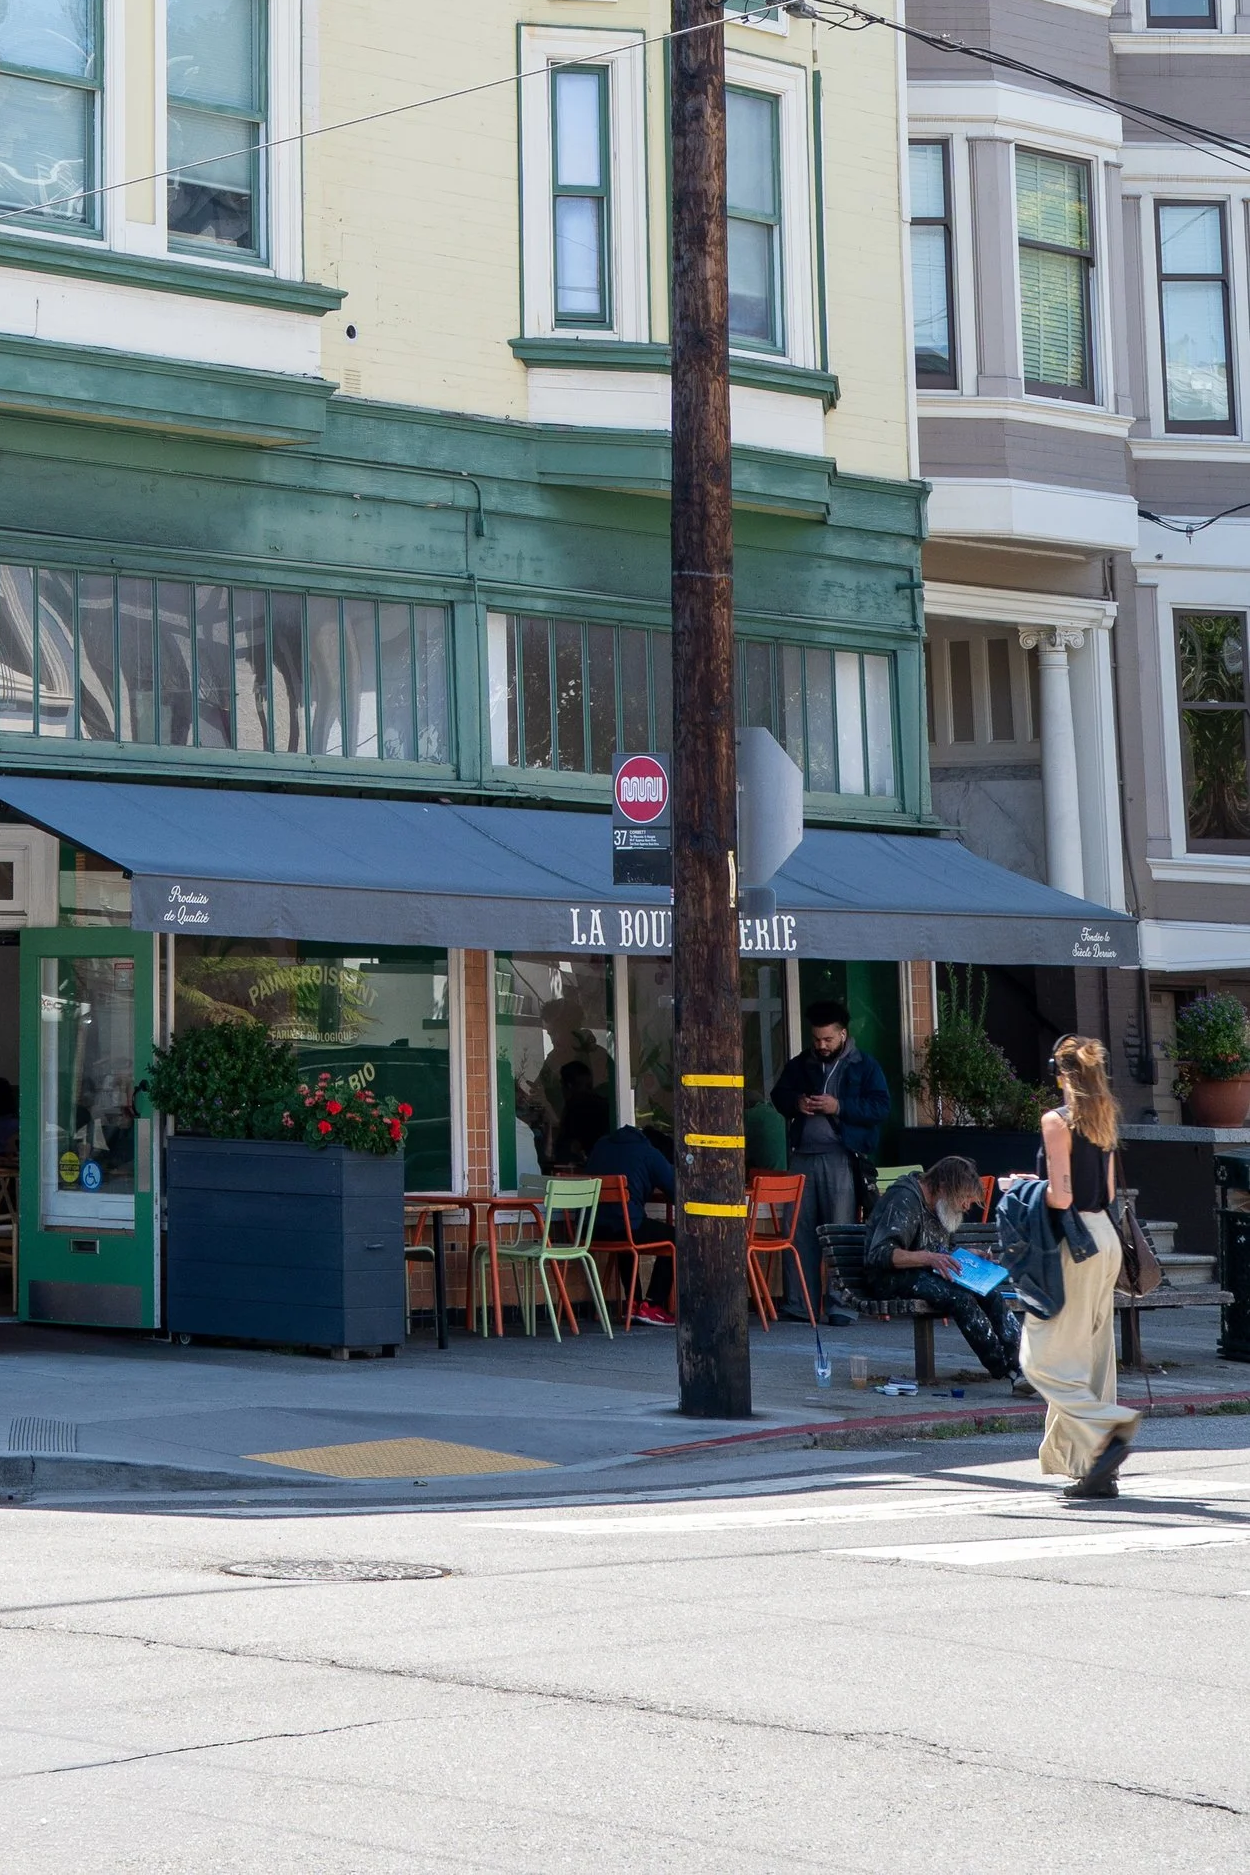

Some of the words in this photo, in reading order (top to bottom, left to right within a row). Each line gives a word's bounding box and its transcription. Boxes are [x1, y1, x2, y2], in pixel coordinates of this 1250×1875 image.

[613, 830, 628, 846] 37
[168, 885, 210, 905] Produits
[163, 910, 177, 922] de
[177, 905, 210, 925] Qualité
[570, 908, 606, 946] LA
[618, 909, 798, 952] BOUERIE
[1092, 943, 1117, 957] Dernier
[307, 1030, 359, 1043] BIOLOGIQUES
[348, 1062, 376, 1091] BIO
